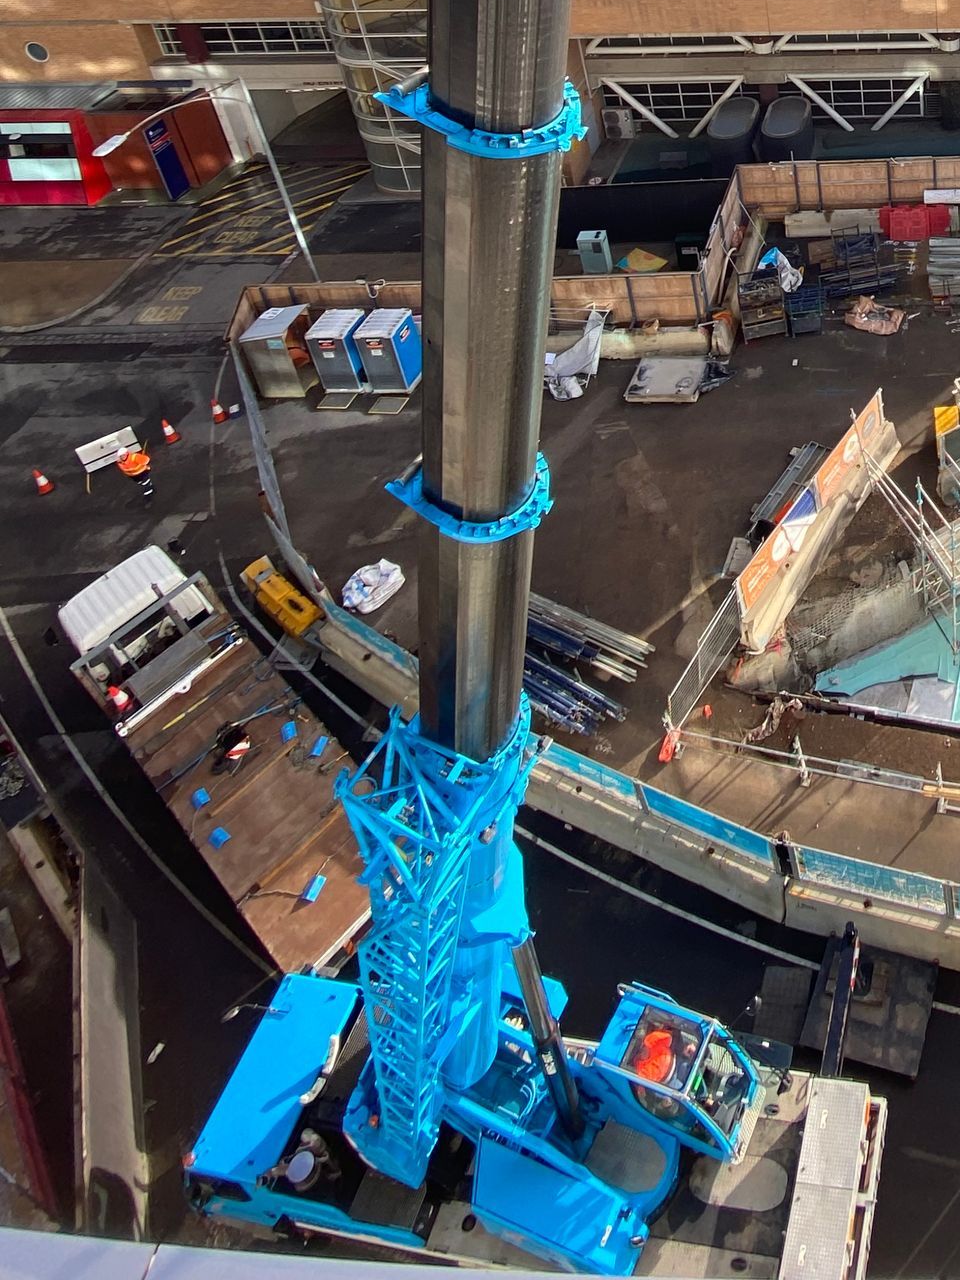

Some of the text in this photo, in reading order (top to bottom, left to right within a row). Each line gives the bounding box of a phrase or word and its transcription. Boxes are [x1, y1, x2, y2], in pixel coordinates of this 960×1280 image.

[235, 216, 272, 228] KEEP
[213, 231, 259, 244] CLEAR
[162, 287, 203, 301] KEEP
[138, 306, 189, 323] CLEAR
